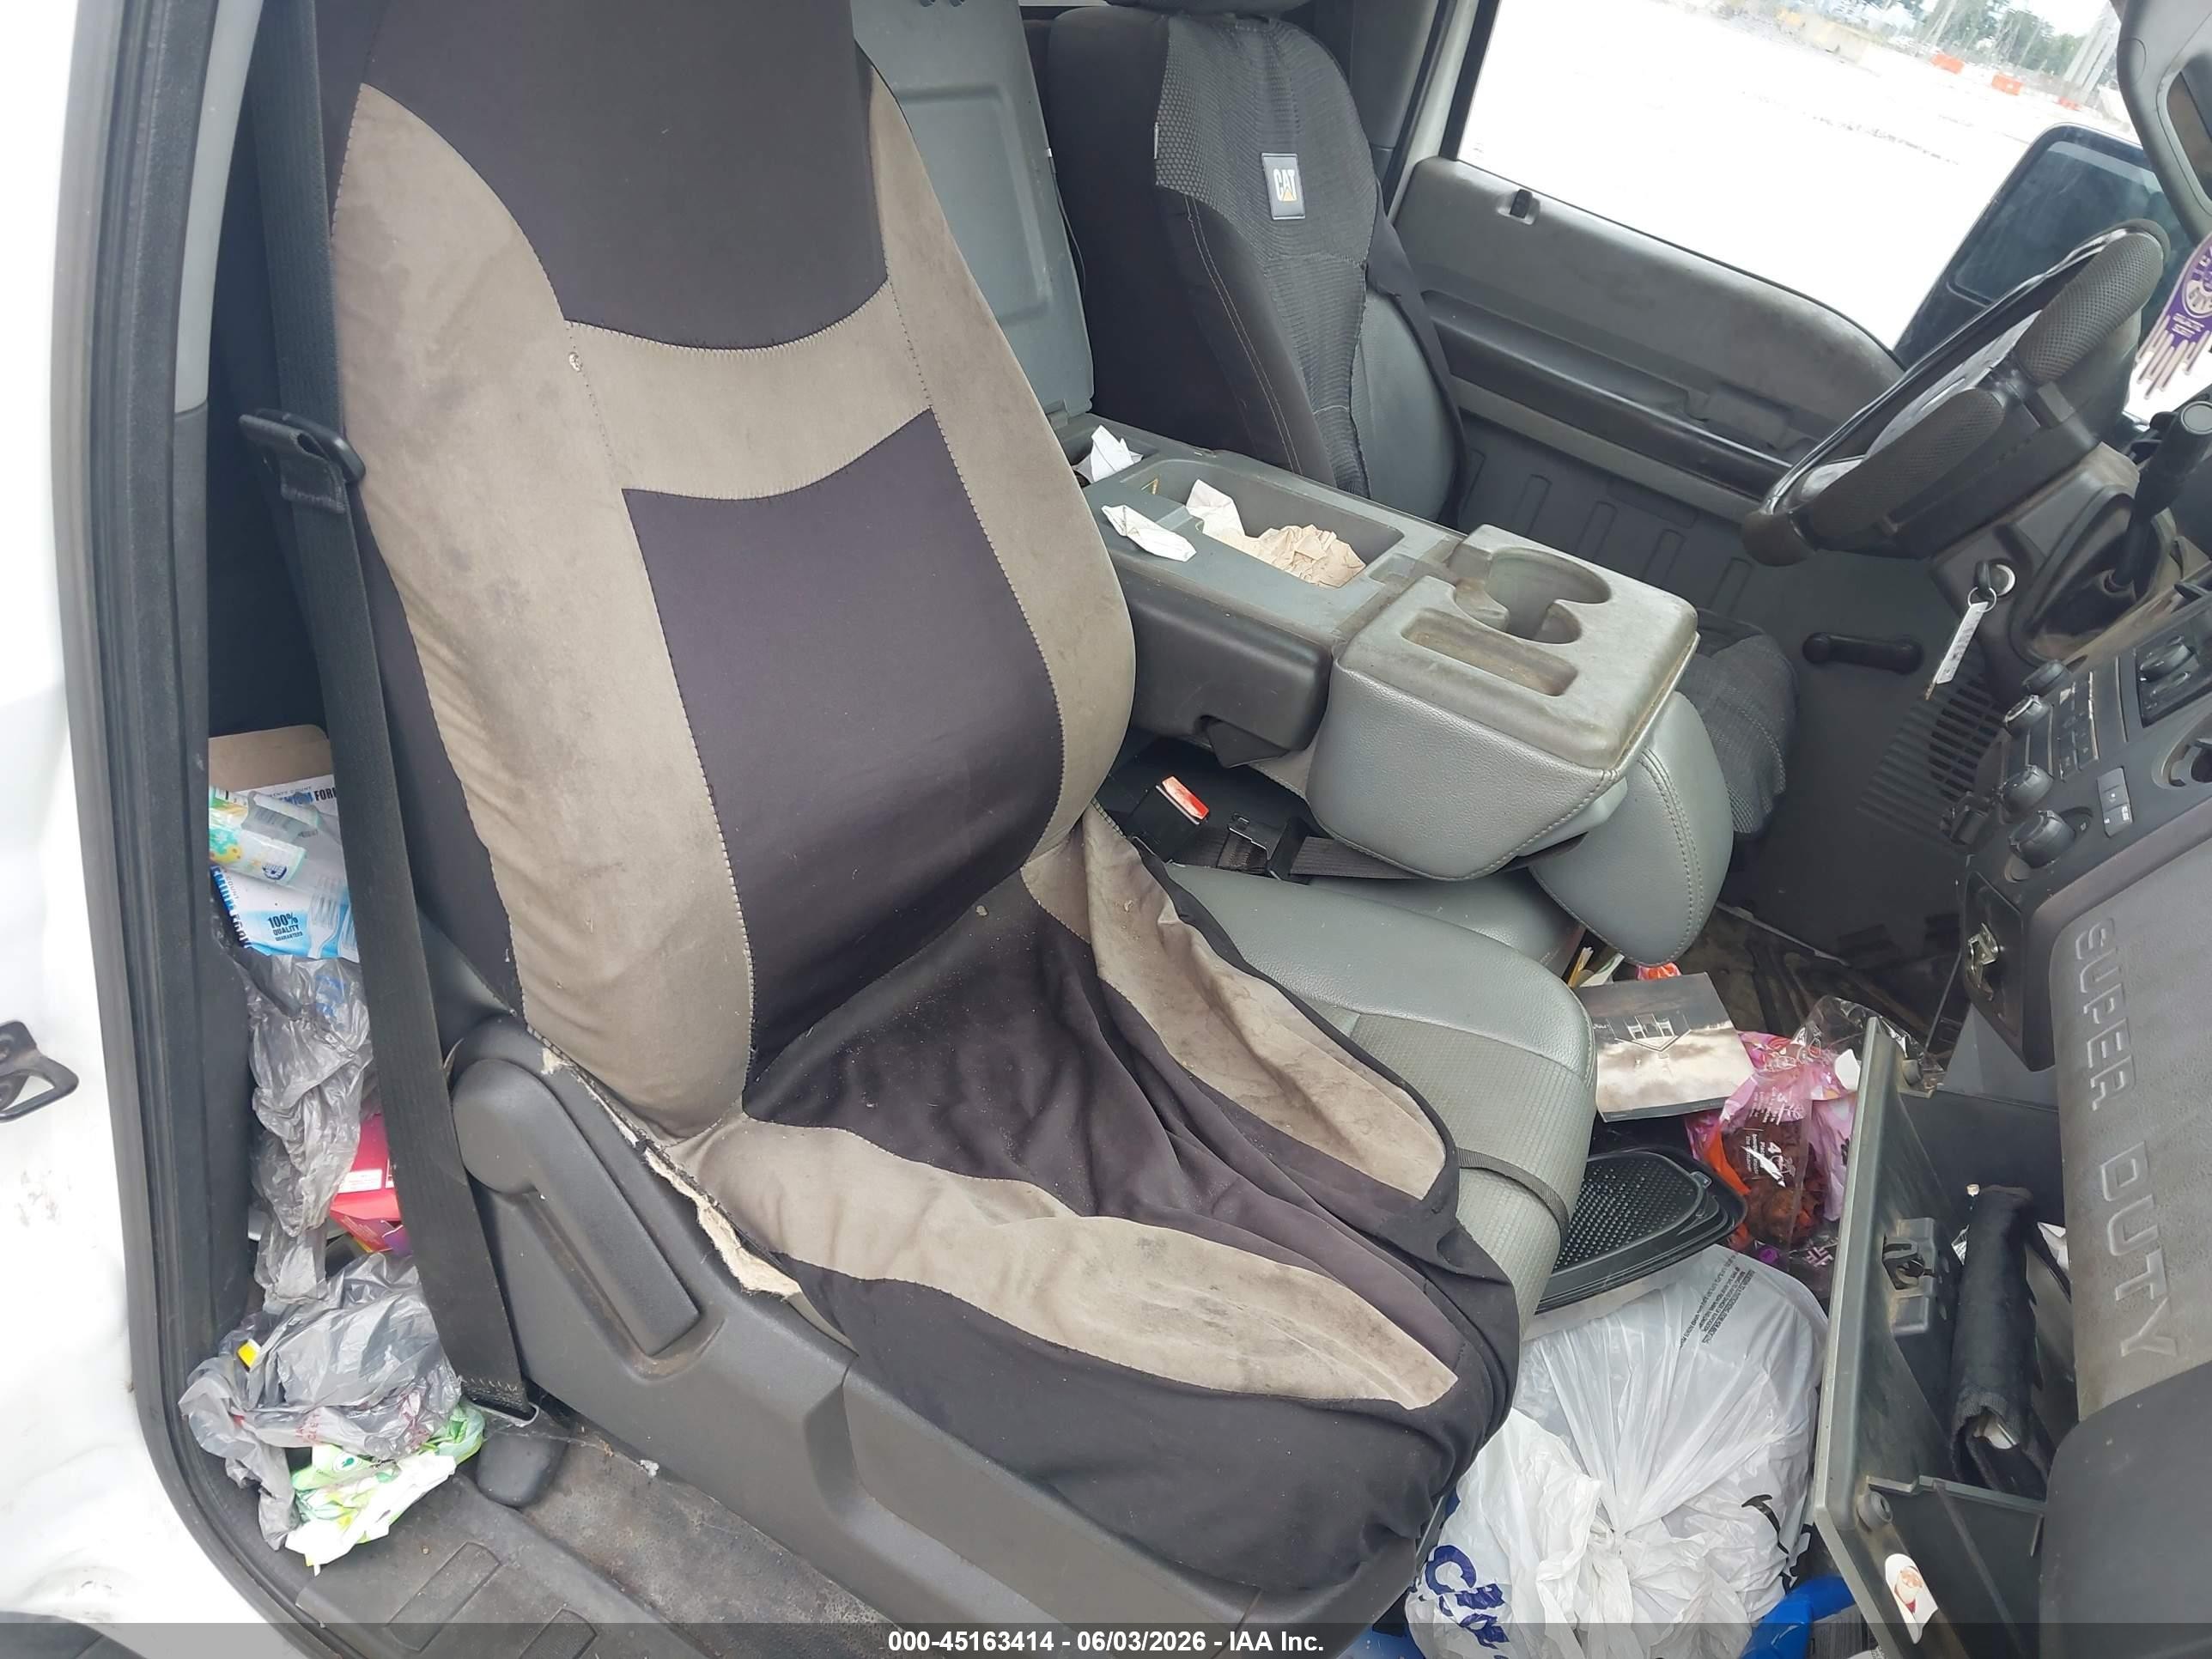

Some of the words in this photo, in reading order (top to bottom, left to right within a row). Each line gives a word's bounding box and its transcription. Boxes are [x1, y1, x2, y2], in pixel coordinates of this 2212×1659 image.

[1273, 168, 1297, 202] CAT
[267, 912, 299, 929] 100%
[272, 924, 300, 936] QUALITY
[2075, 918, 2136, 1112] SUPER
[1767, 1141, 1782, 1154] 4
[2100, 1139, 2179, 1358] DUTY
